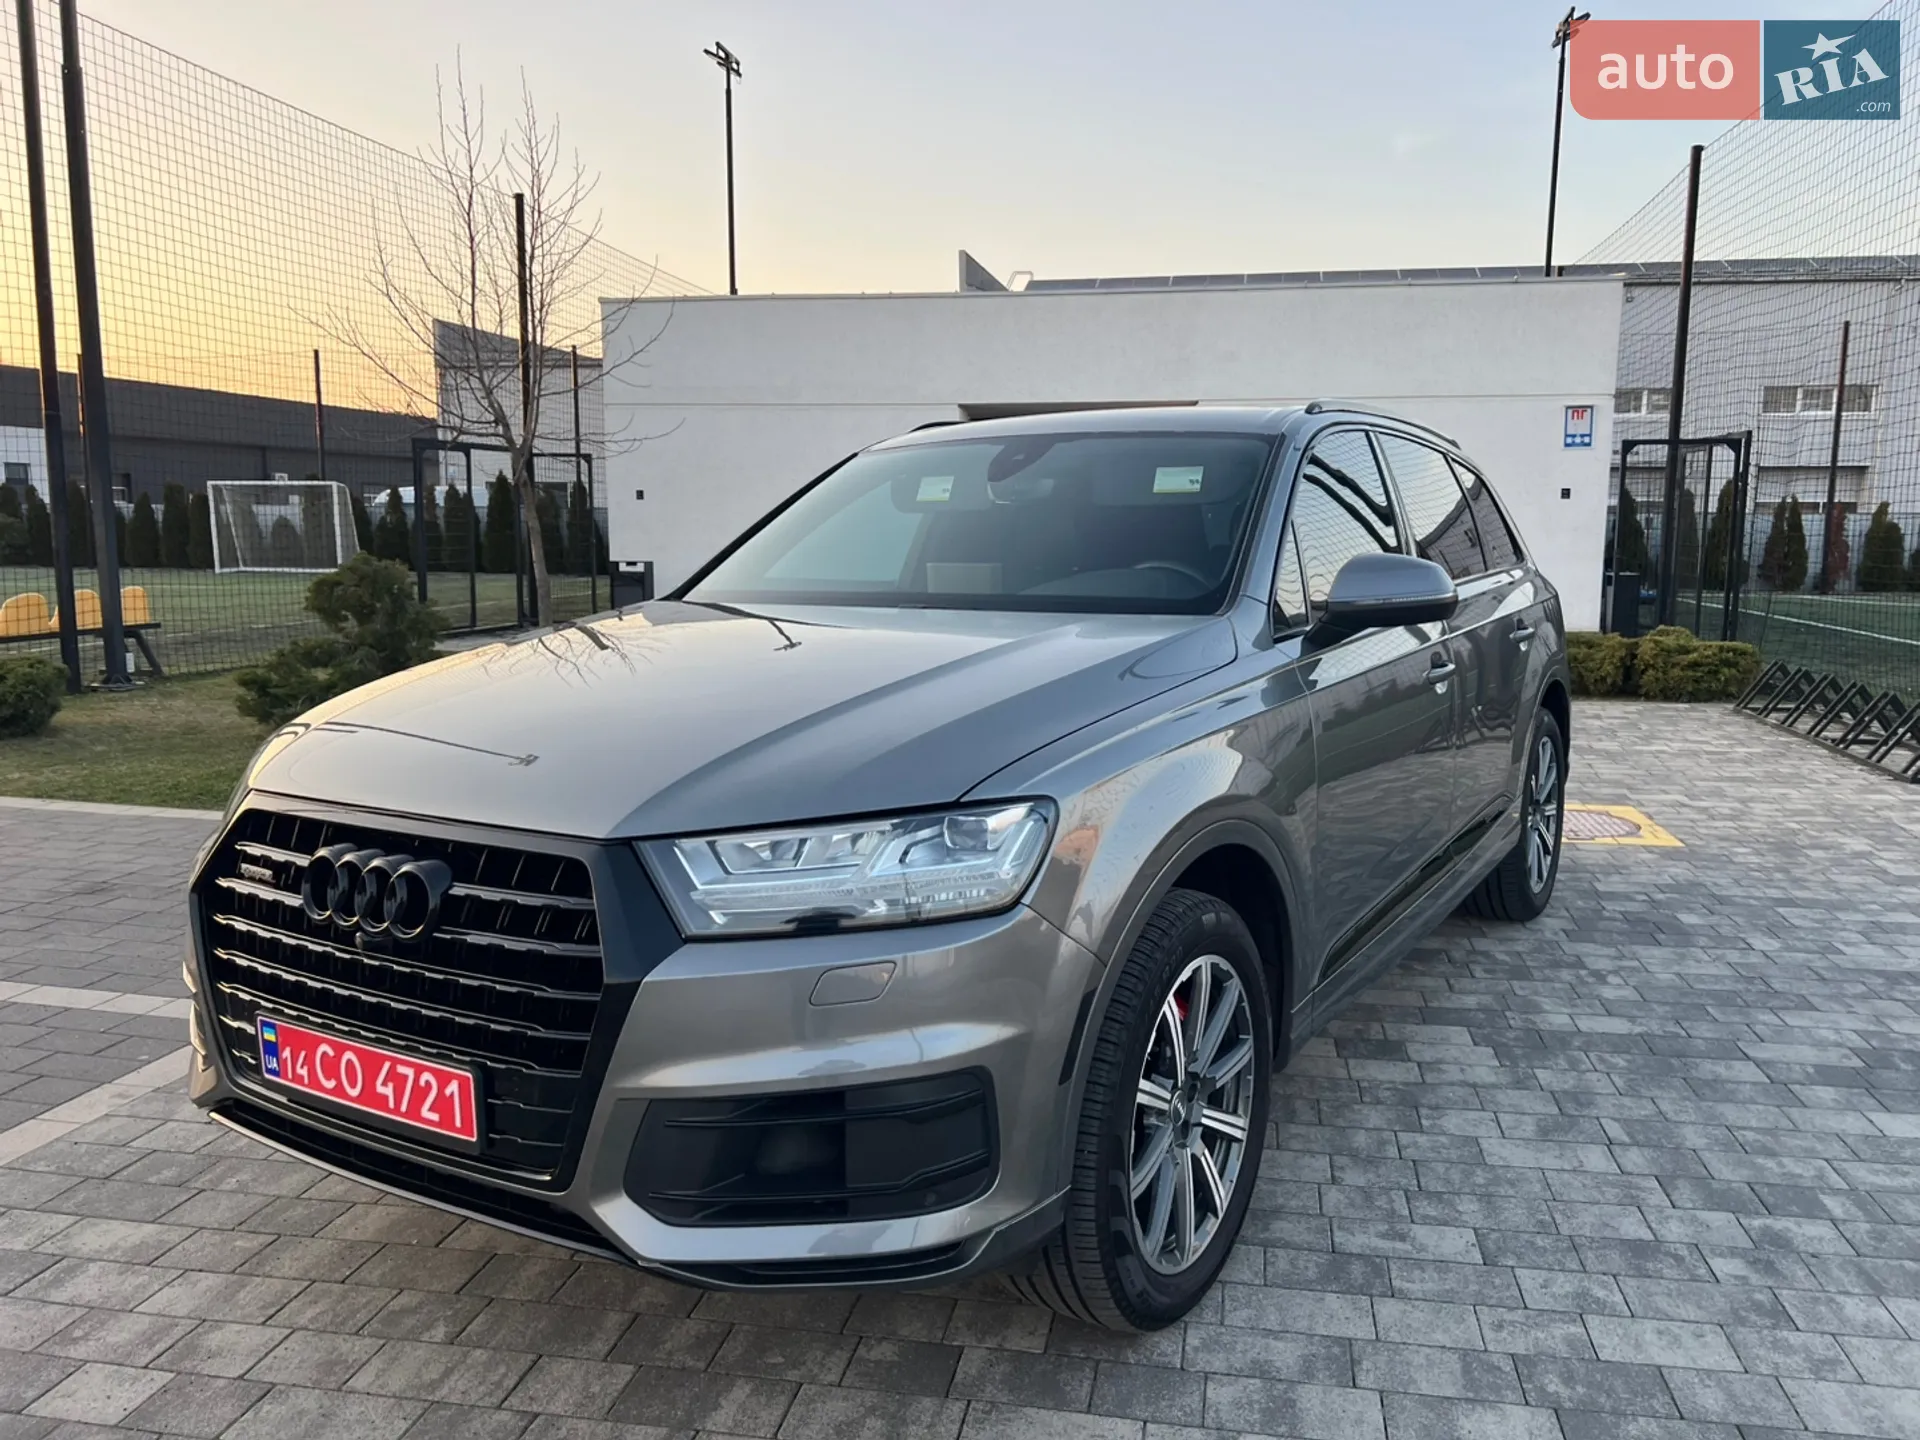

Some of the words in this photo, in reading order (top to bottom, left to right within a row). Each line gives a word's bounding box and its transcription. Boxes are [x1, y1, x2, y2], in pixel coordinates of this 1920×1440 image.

[265, 1054, 279, 1072] UA
[281, 1046, 309, 1085] 14
[315, 1042, 363, 1097] CO
[375, 1060, 462, 1129] 4721
